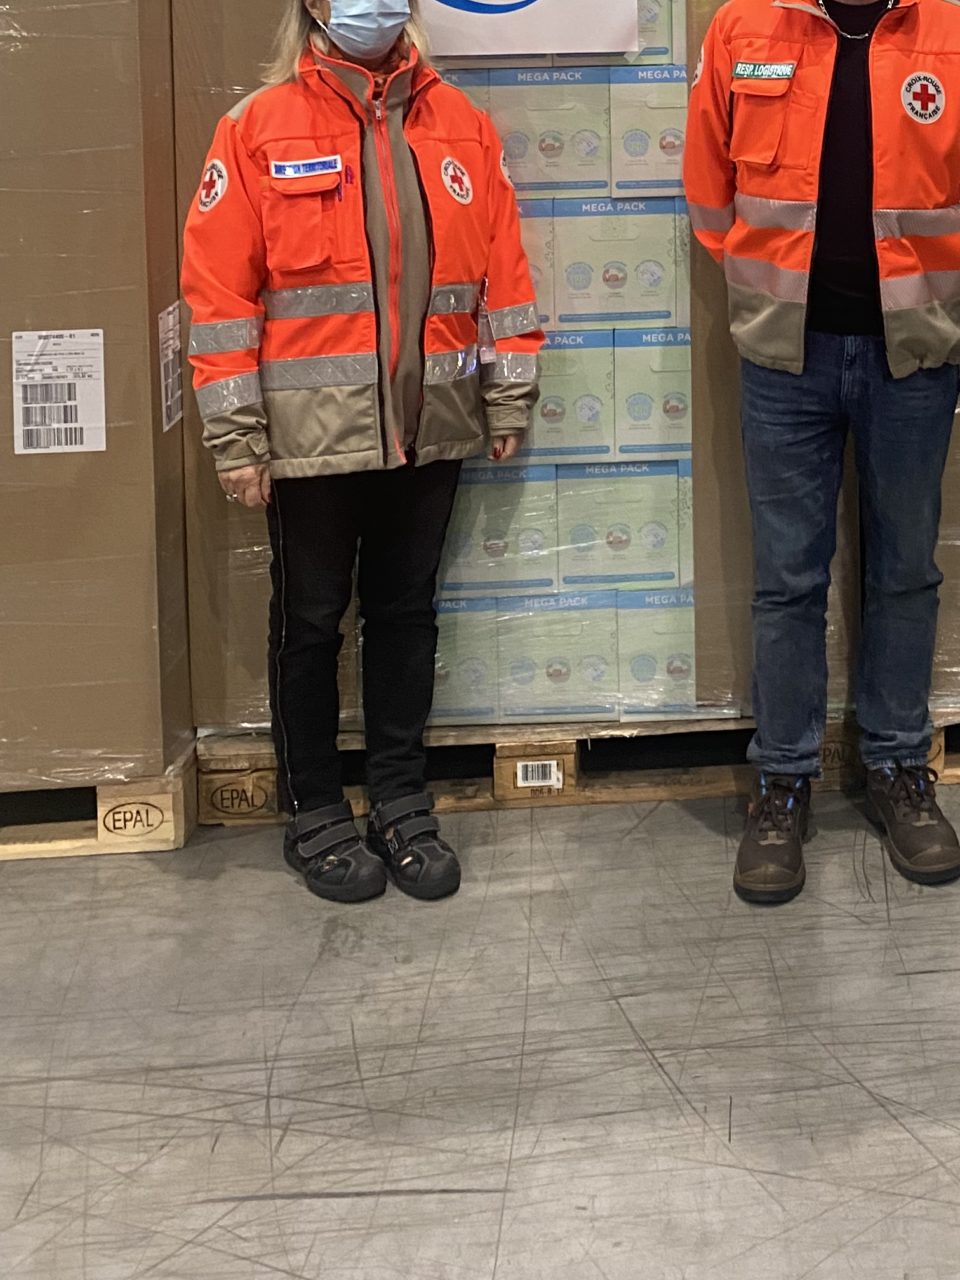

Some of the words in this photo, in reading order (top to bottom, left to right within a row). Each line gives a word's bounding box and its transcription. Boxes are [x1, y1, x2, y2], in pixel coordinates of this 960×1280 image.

[518, 73, 549, 81] MEGA
[553, 72, 582, 80] PACK
[638, 71, 670, 79] MEGA
[582, 203, 614, 212] MEGA
[617, 202, 646, 211] PACK
[555, 336, 584, 345] PACK
[642, 333, 674, 342] MEGA
[586, 465, 617, 474] MEGA
[620, 463, 649, 472] PACK
[439, 599, 467, 608] PACK
[525, 598, 556, 607] MEGA
[559, 597, 588, 606] PACK
[645, 596, 677, 605] MEGA
[220, 789, 259, 809] EPAL
[112, 808, 154, 830] EPAL
